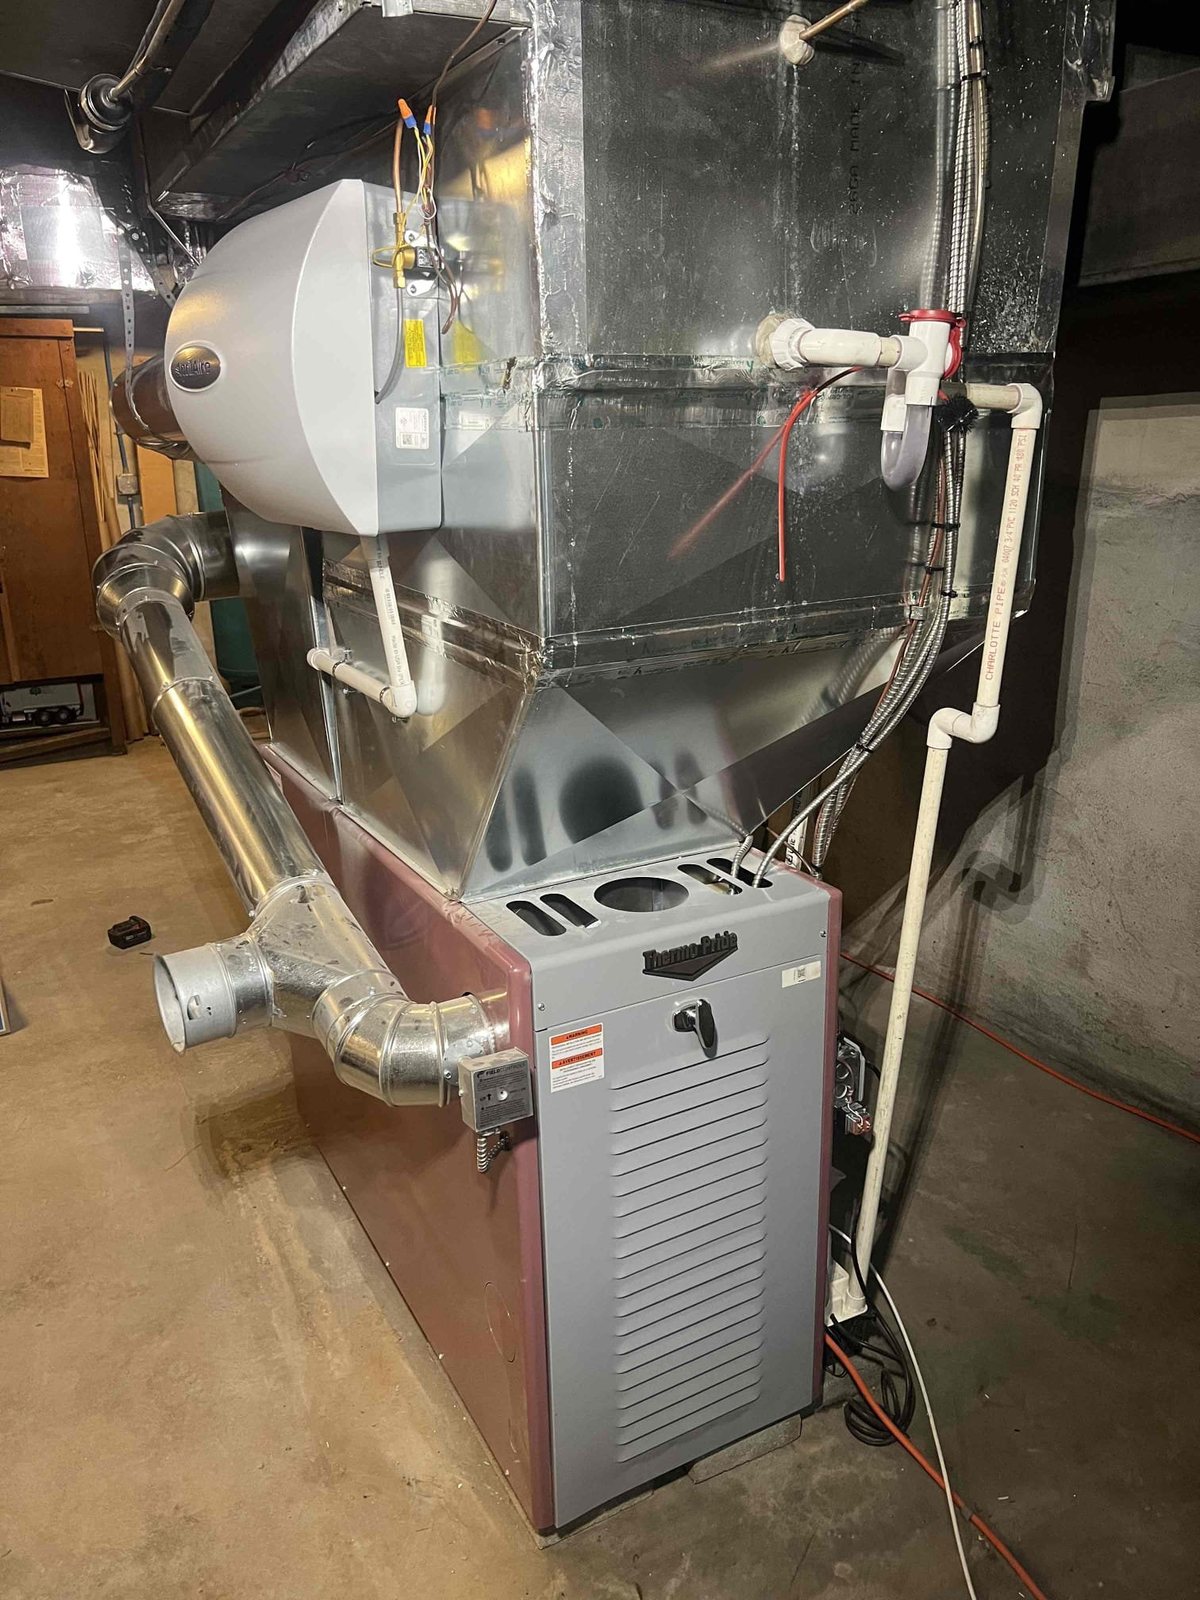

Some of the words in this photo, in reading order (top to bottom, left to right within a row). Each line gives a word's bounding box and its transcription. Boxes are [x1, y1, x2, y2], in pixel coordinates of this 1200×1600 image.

[985, 620, 1001, 681] CHARLOTTE
[1011, 485, 1020, 497] SCH
[642, 943, 699, 970] Thermo
[700, 930, 738, 956] Pride
